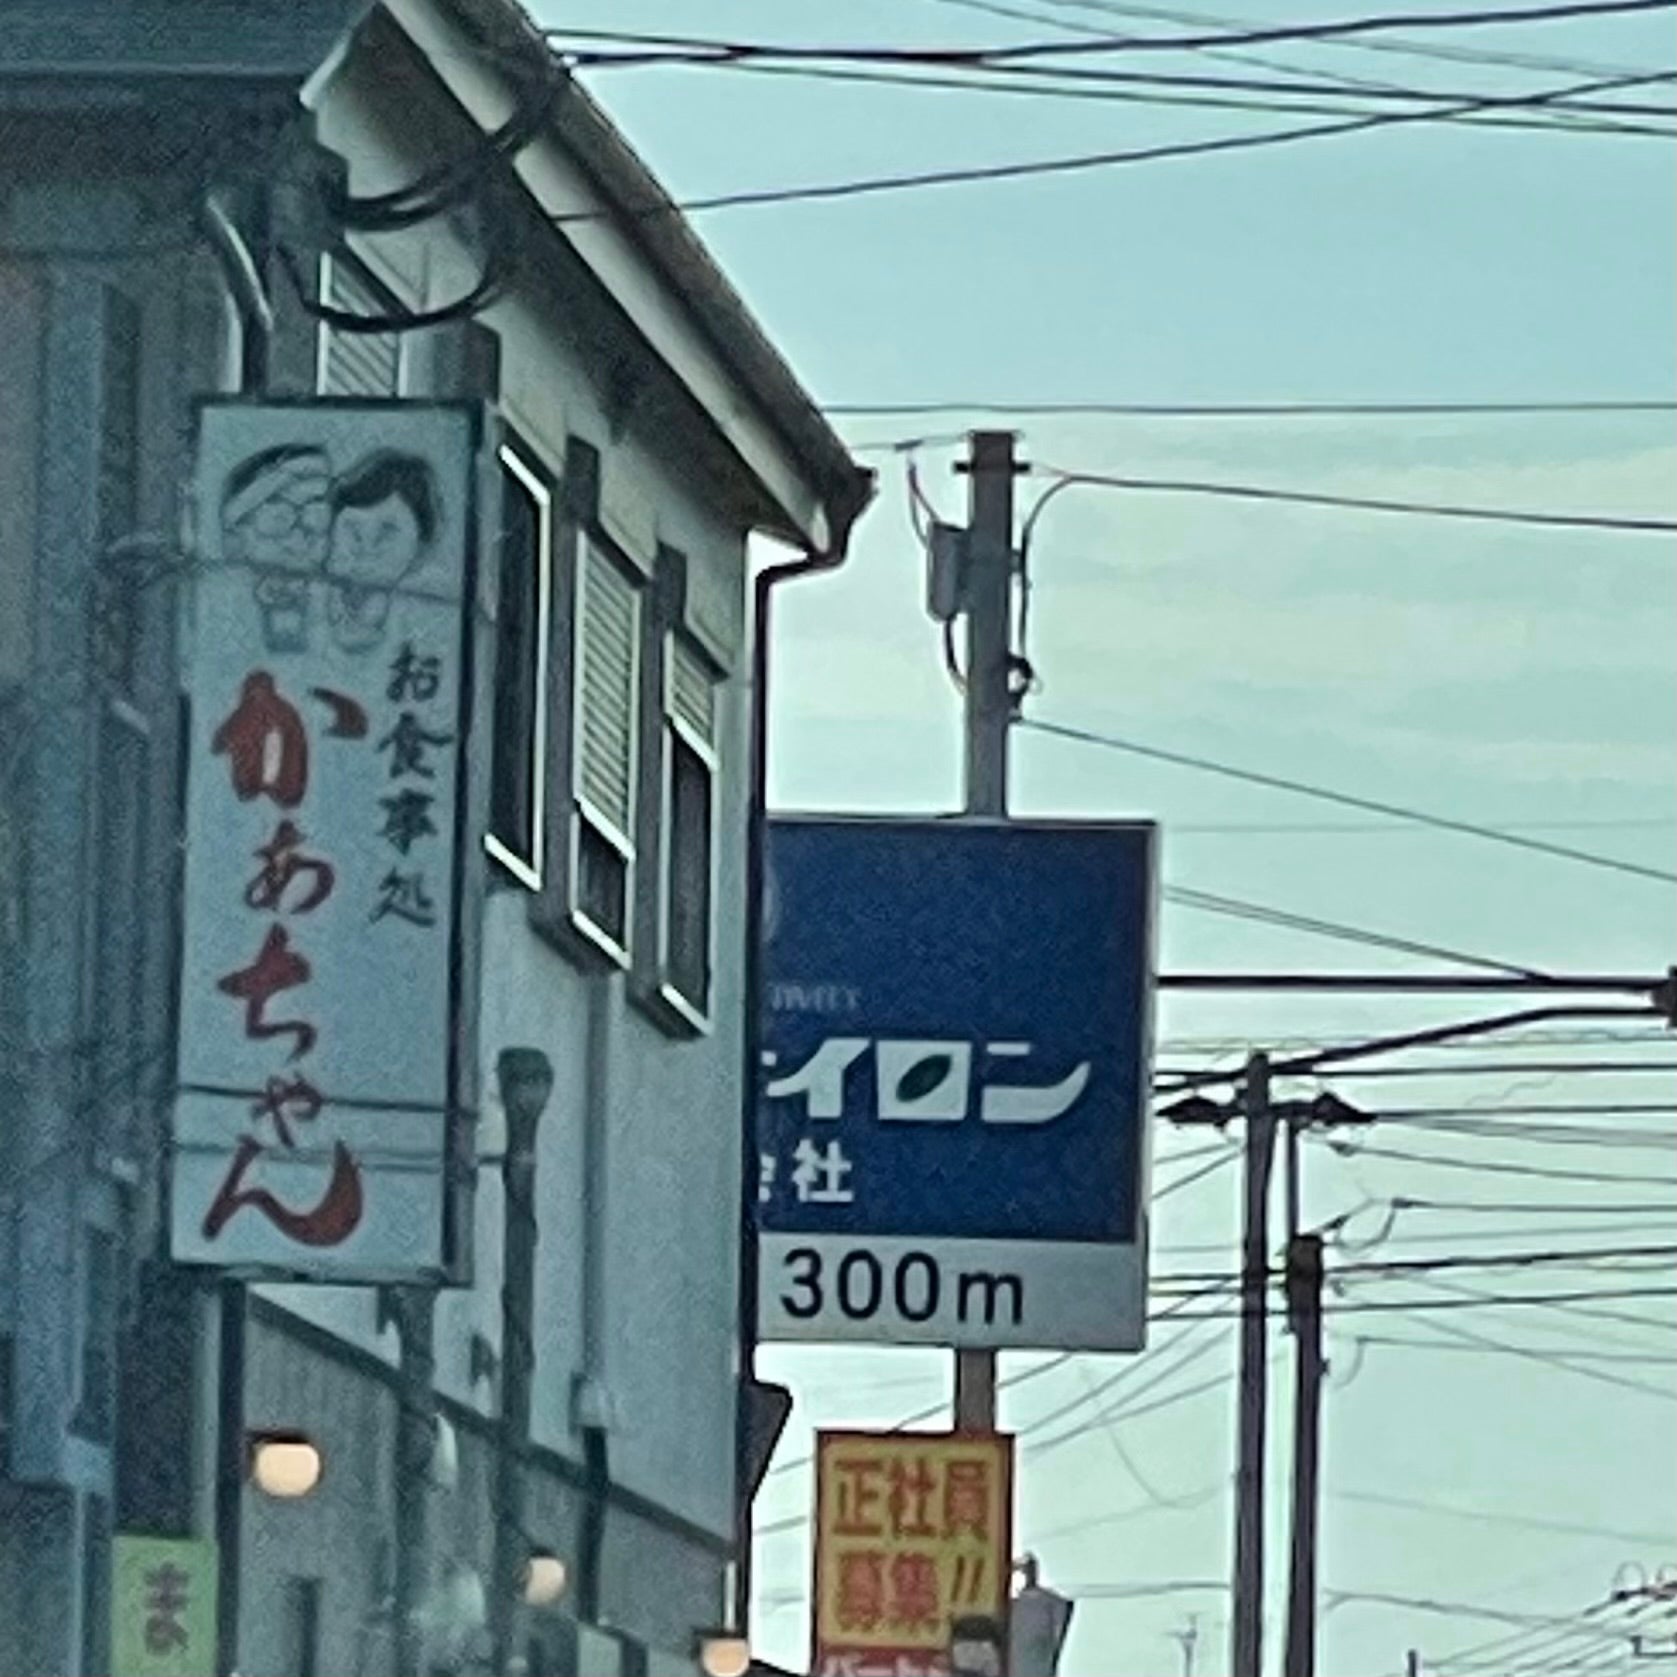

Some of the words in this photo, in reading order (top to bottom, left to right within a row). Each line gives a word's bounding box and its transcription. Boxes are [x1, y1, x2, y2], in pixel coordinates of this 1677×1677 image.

[761, 1036, 1092, 1124] イロン
[780, 1248, 1023, 1326] 300m
[833, 1458, 990, 1541] 正社員
